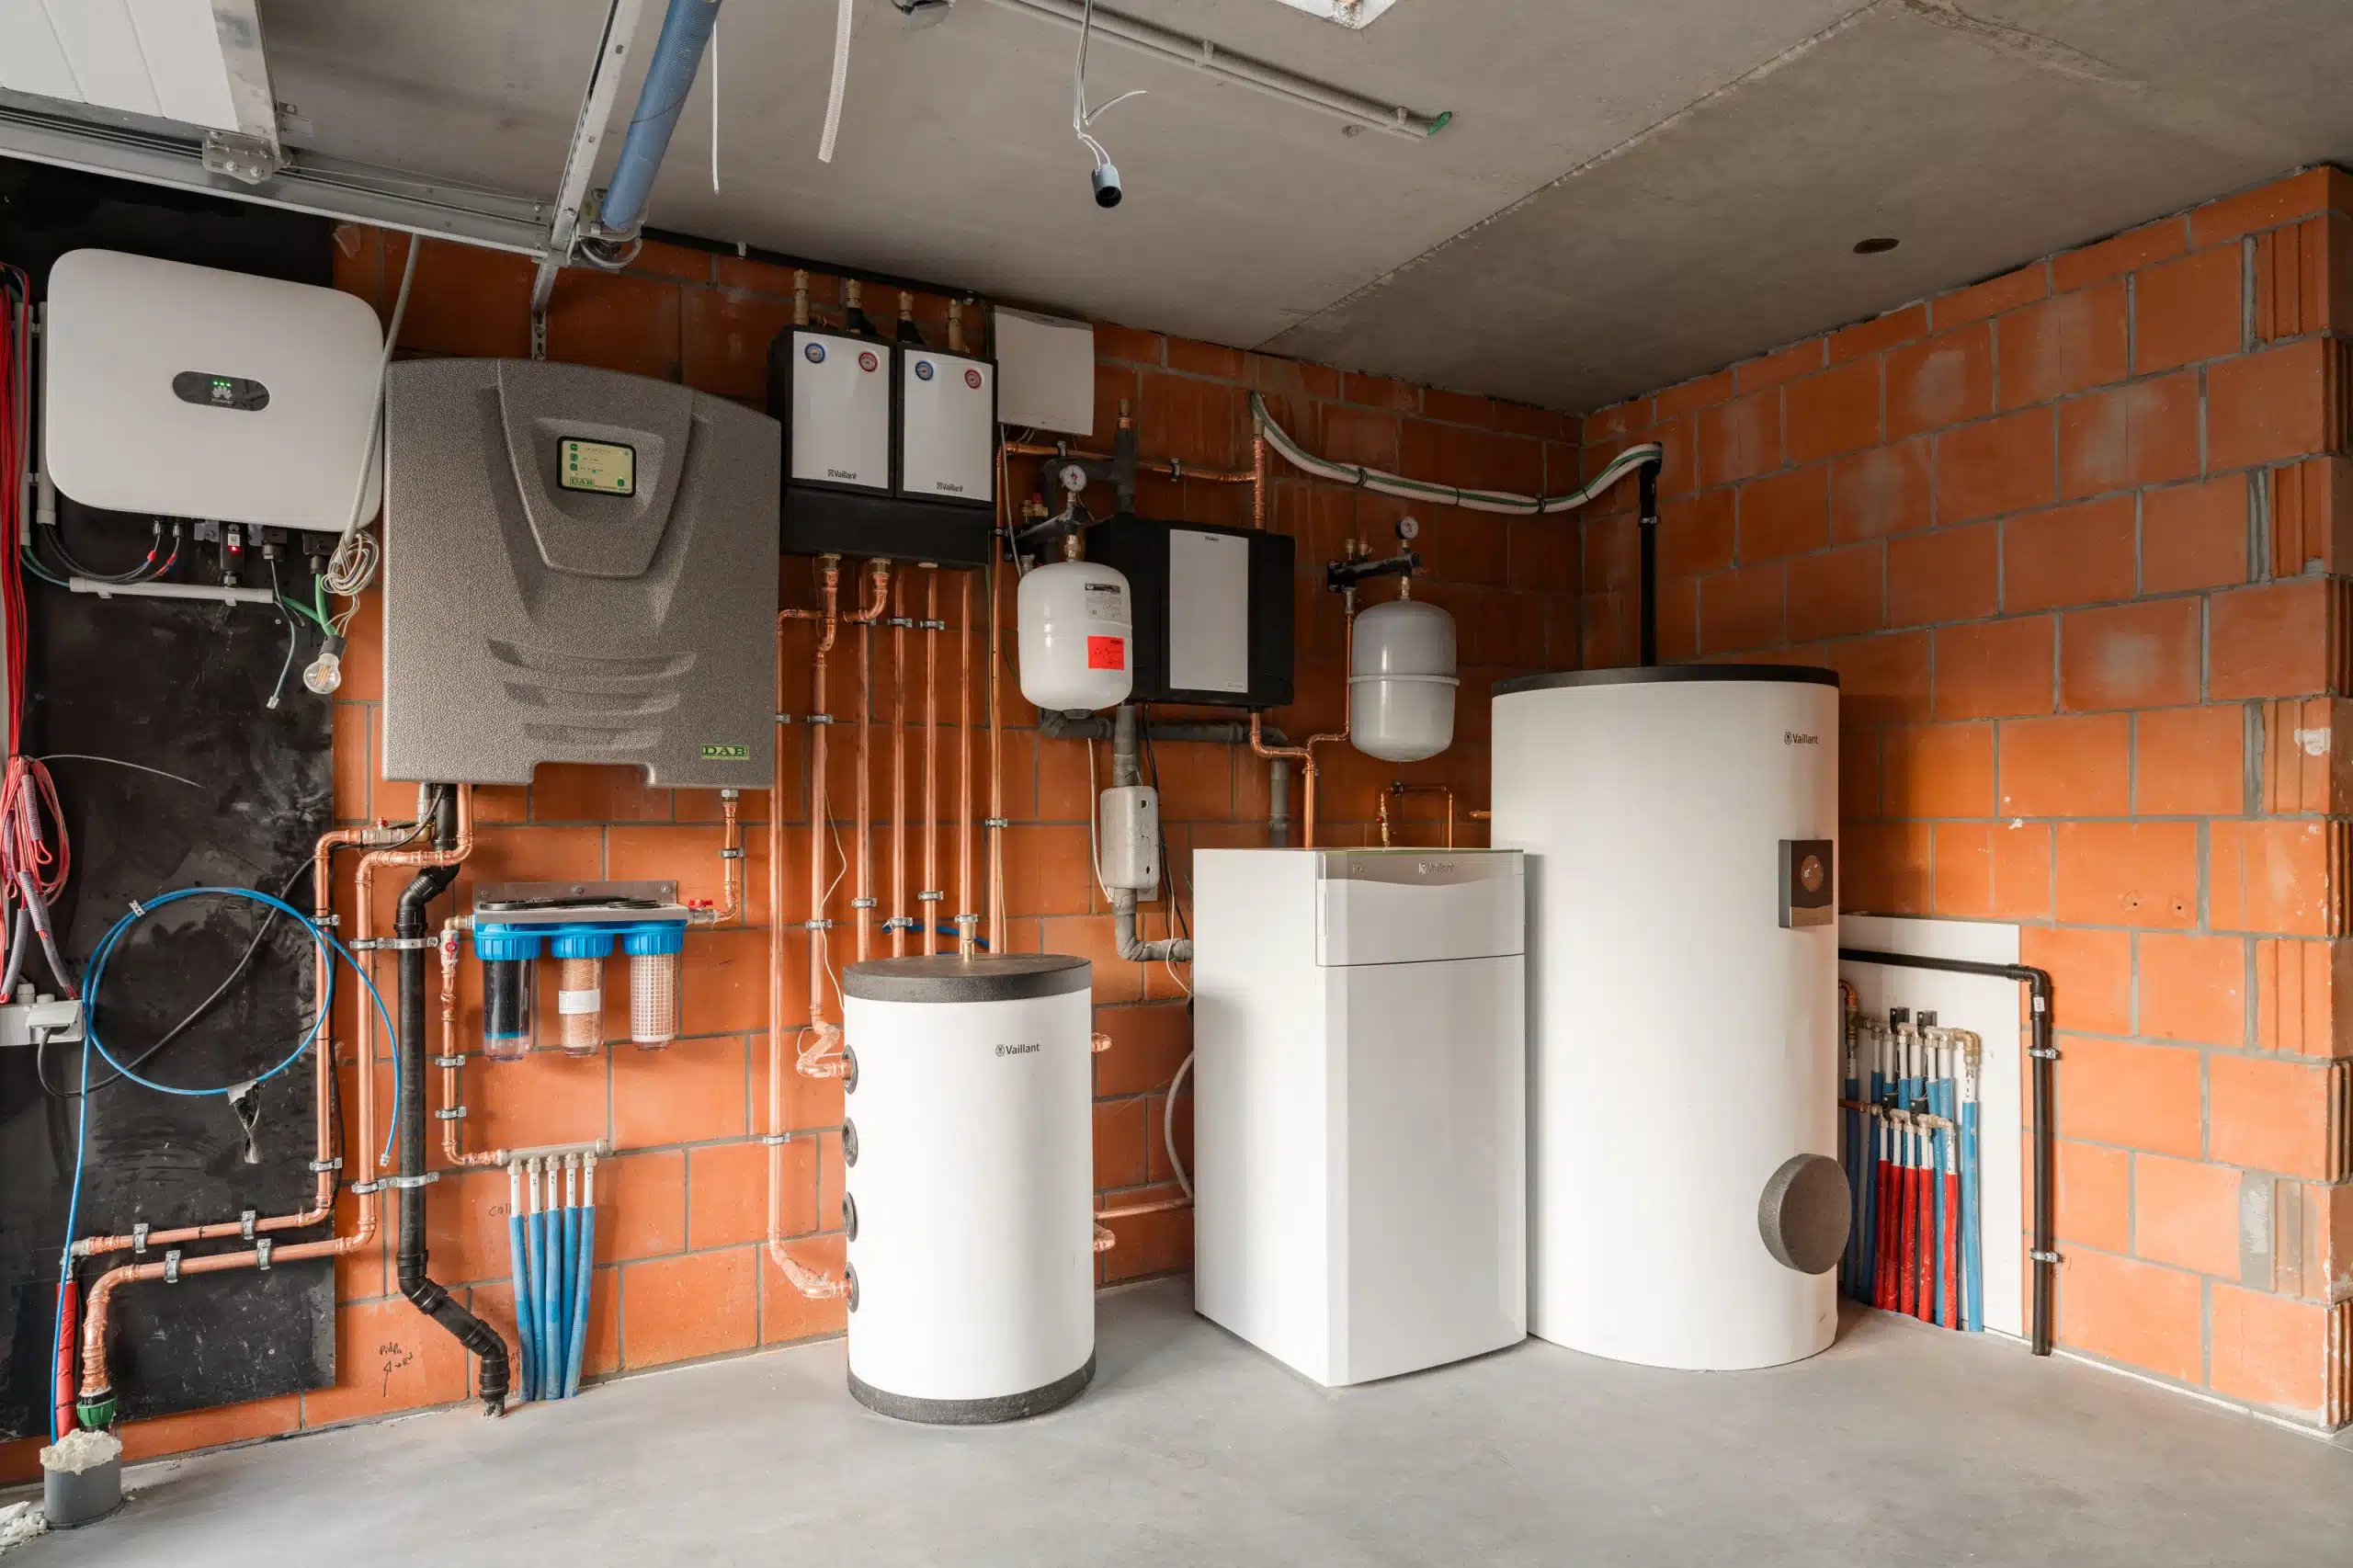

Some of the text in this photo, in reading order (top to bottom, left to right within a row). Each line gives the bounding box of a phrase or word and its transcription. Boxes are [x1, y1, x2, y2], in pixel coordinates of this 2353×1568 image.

[835, 470, 858, 480] Vaillant
[942, 482, 963, 493] Vaillant
[1793, 733, 1819, 744] Vaillant
[704, 745, 747, 756] DAB
[1427, 862, 1455, 873] Vaillant
[1006, 1042, 1040, 1055] Vaillant
